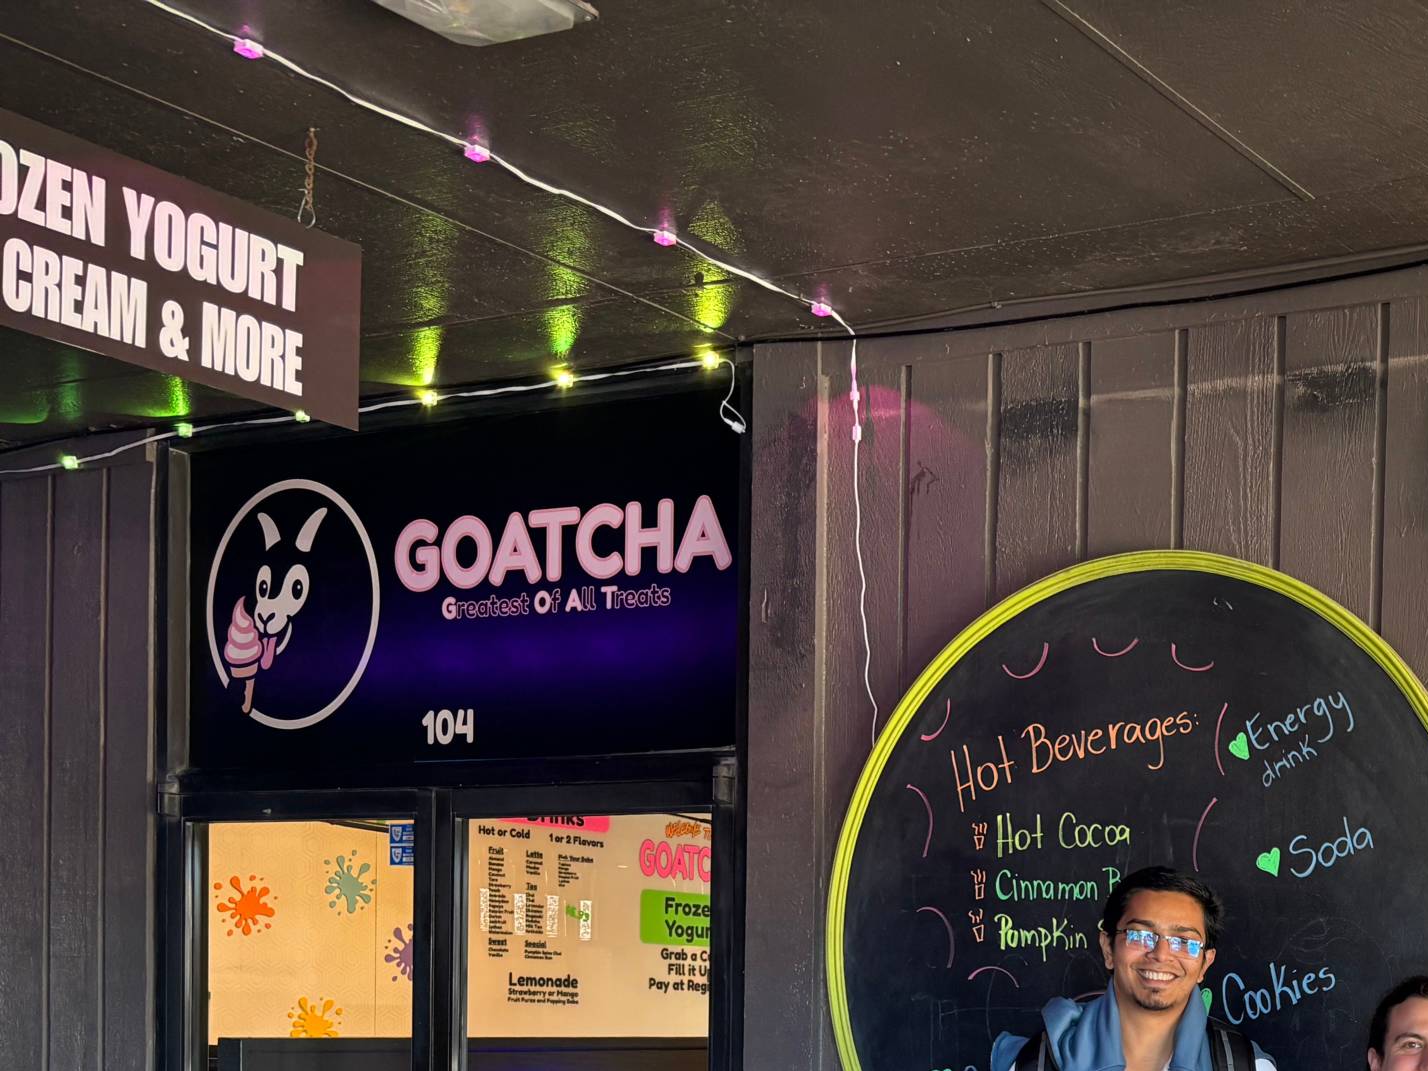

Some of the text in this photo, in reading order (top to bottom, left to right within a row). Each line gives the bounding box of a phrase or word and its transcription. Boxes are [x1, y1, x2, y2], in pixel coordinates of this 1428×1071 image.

[0, 139, 304, 312] OZEN YOGURT
[2, 238, 303, 397] CREAM & MORE
[394, 494, 733, 592] GOATCHA
[441, 584, 671, 620] Greatest Of All Treats
[421, 708, 474, 745] 104
[1246, 691, 1355, 750] Energy
[951, 711, 1200, 813] Hot Beverages:
[478, 825, 530, 839] Hot or Cold
[549, 833, 605, 848] 1 or 2 Flavors
[997, 812, 1130, 858] Hot Cocoa
[1289, 816, 1374, 878] Soda
[639, 838, 711, 883] GOATC
[995, 869, 1098, 901] Cinnamon
[664, 897, 711, 918] Froze
[660, 948, 688, 961] Grab
[690, 953, 697, 961] a
[668, 963, 685, 976] Fill
[688, 964, 696, 976] it
[509, 971, 578, 988] Lemonade
[648, 978, 670, 994] Pay
[672, 980, 684, 991] at
